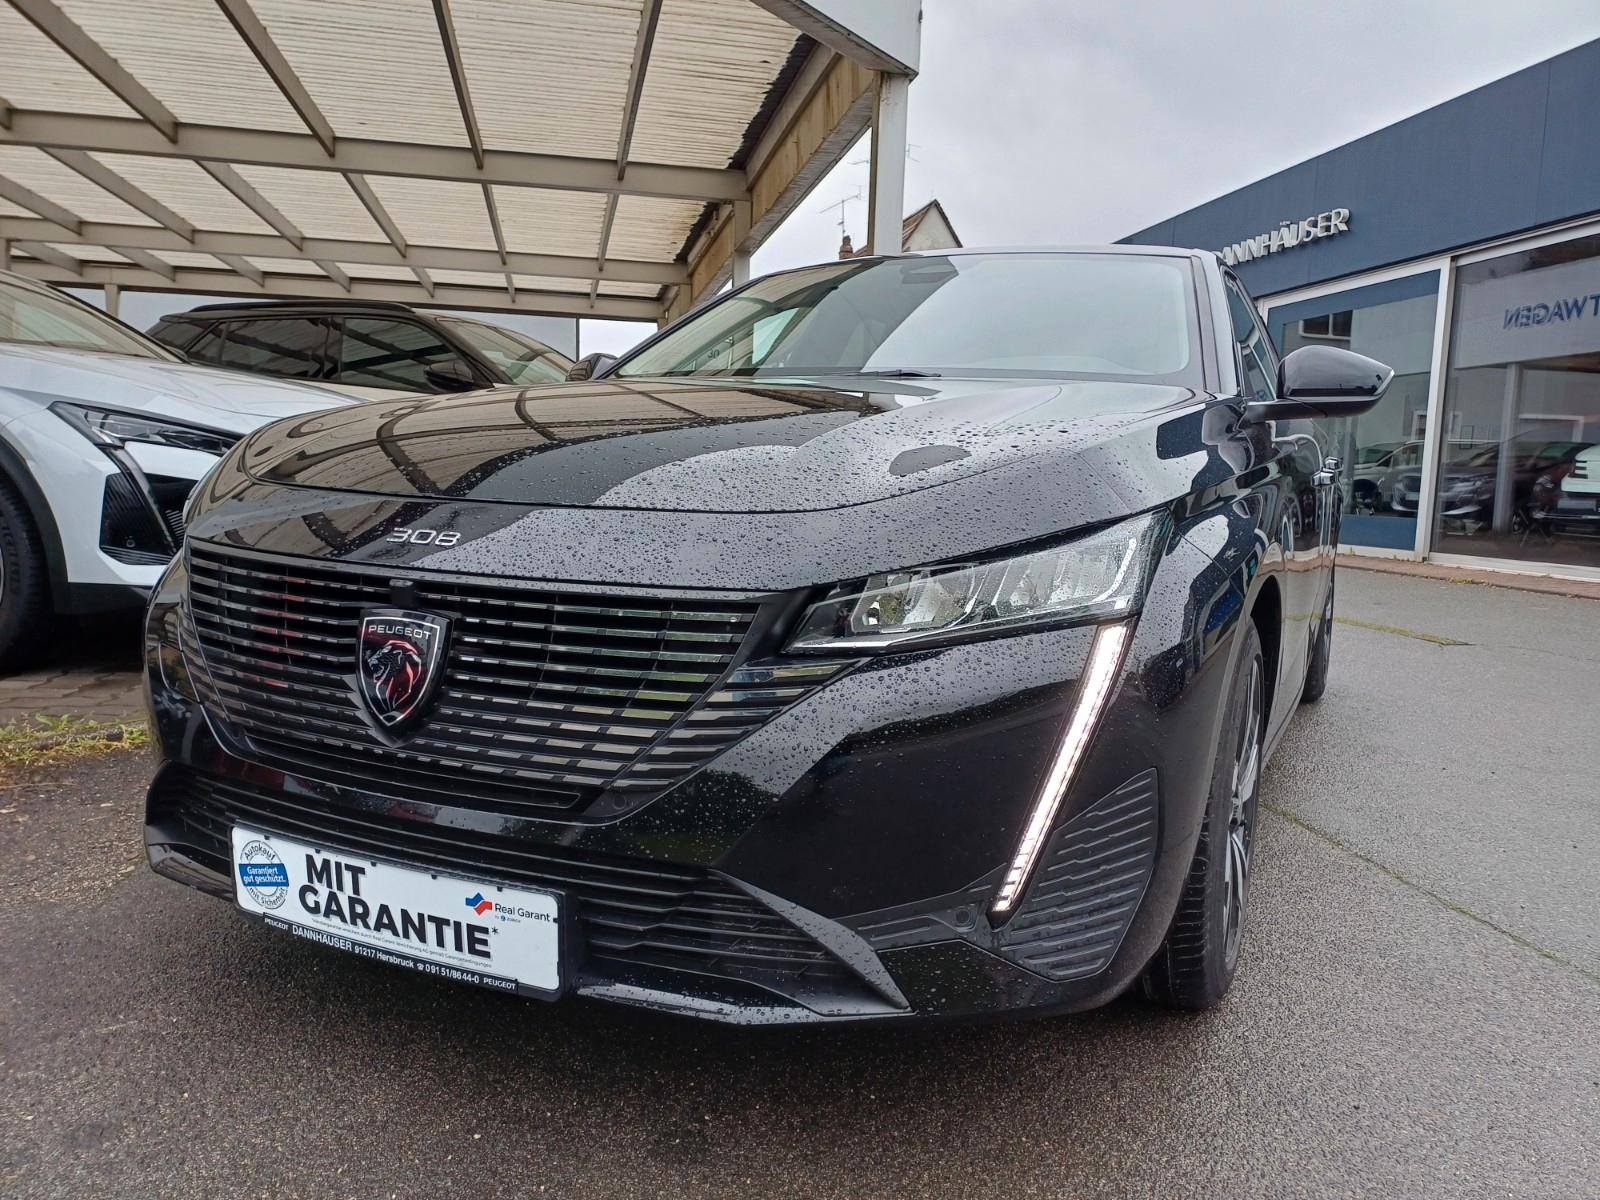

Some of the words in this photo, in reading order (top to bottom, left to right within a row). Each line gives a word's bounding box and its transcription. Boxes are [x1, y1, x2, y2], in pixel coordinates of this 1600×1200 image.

[386, 527, 461, 546] 308
[368, 624, 432, 640] PEUGEOT
[305, 854, 366, 896] MIT
[494, 903, 516, 916] Real
[517, 908, 551, 922] Garant
[264, 918, 289, 931] PEUGEOT
[354, 945, 376, 958] 91217
[376, 951, 415, 969] Hersbruck
[483, 978, 516, 990] PEUGEOT
